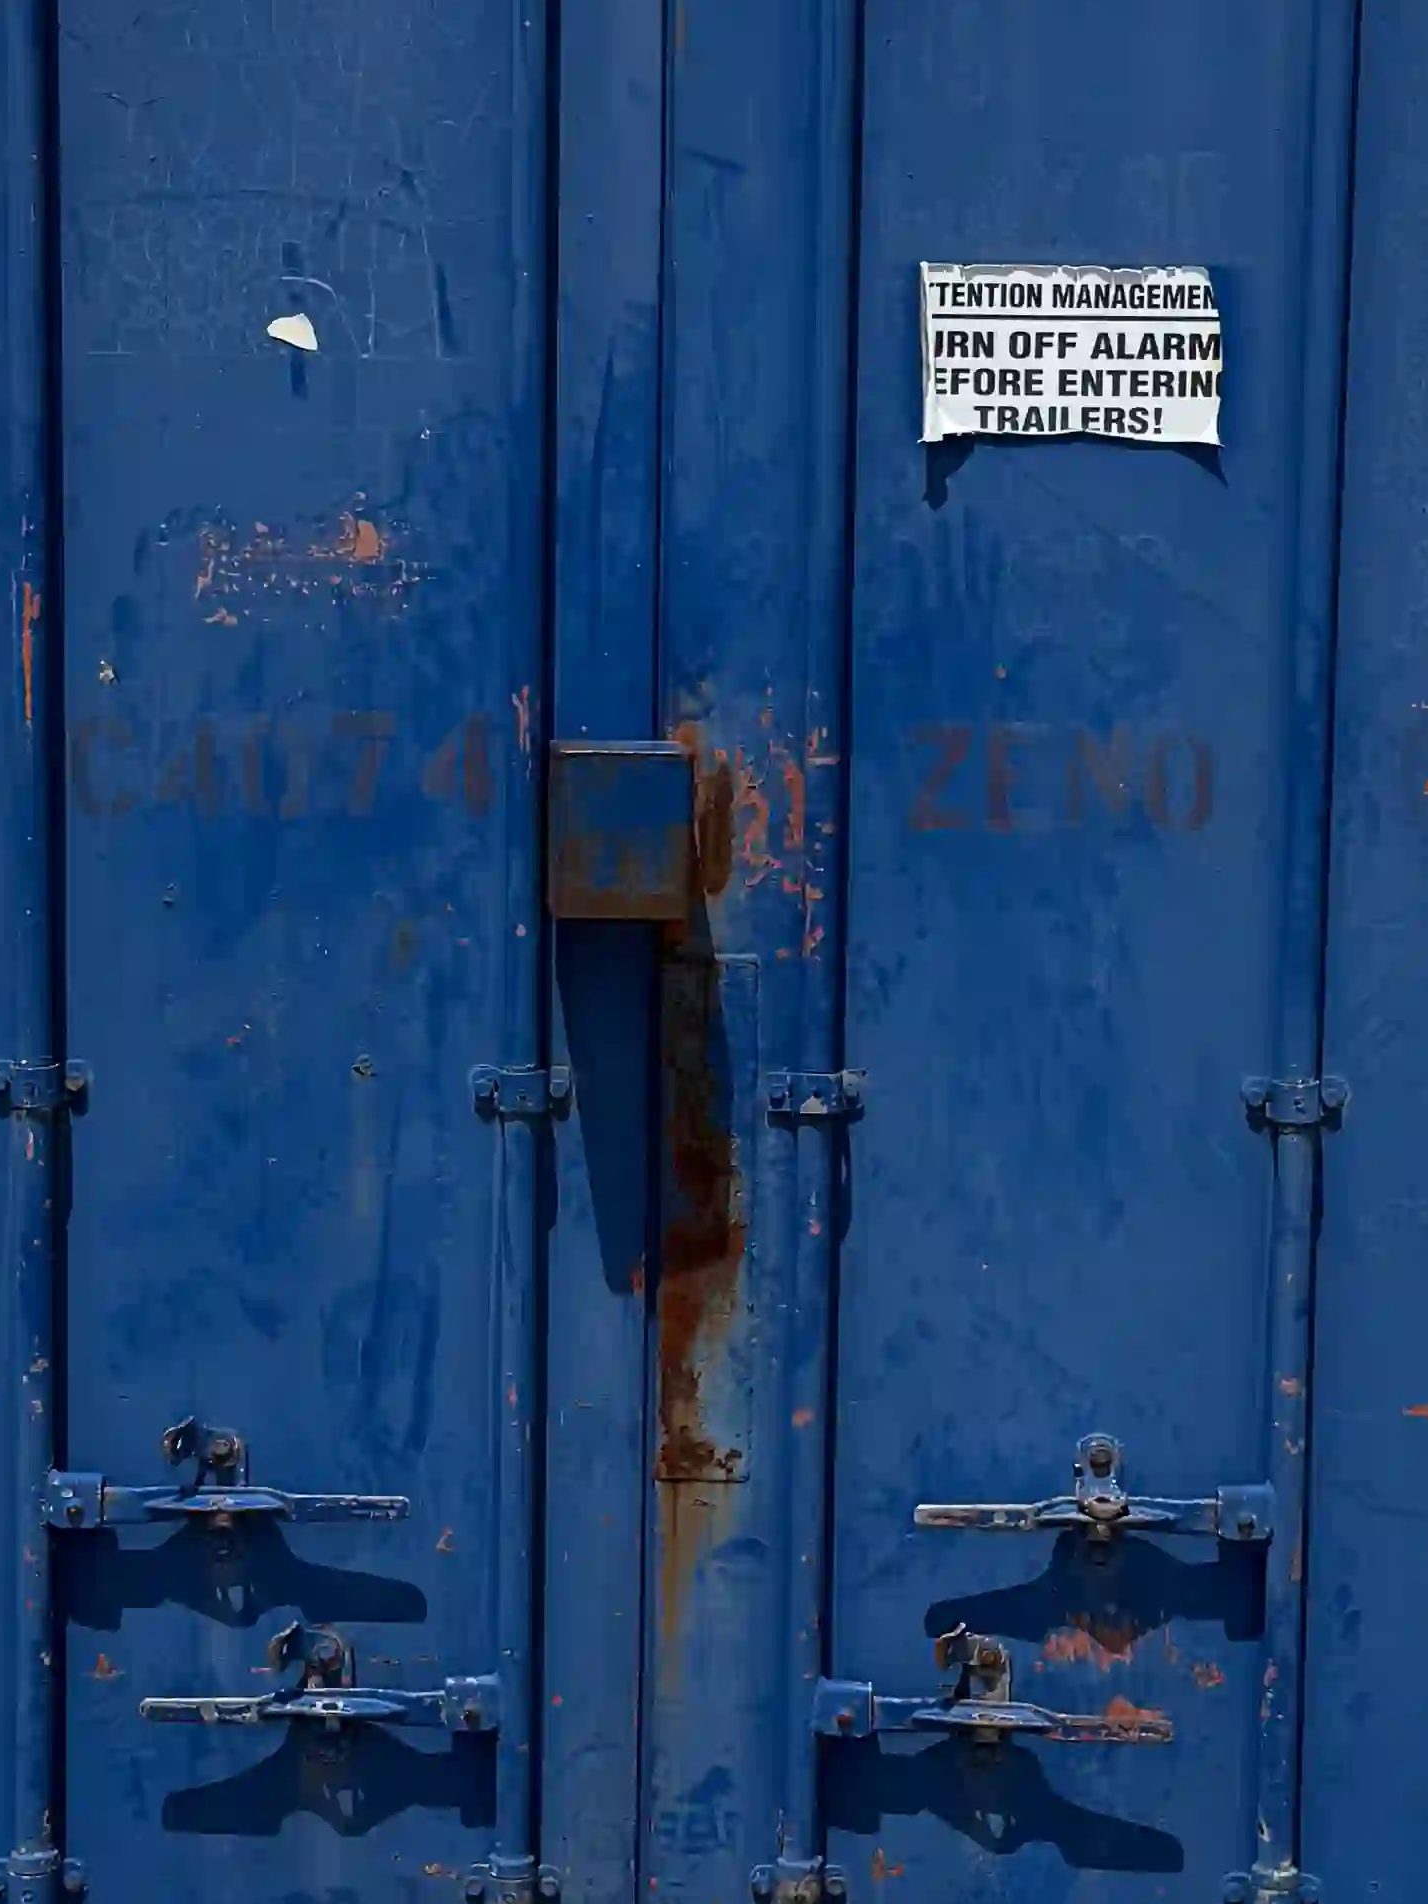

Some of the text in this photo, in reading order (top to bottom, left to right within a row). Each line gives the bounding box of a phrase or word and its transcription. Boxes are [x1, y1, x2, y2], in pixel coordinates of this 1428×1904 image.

[929, 282, 1042, 309] TENTION
[1009, 331, 1078, 359] OFF
[1090, 332, 1220, 360] ALARM
[1058, 369, 1220, 398] ENTERIN
[906, 717, 1215, 833] ZENO
